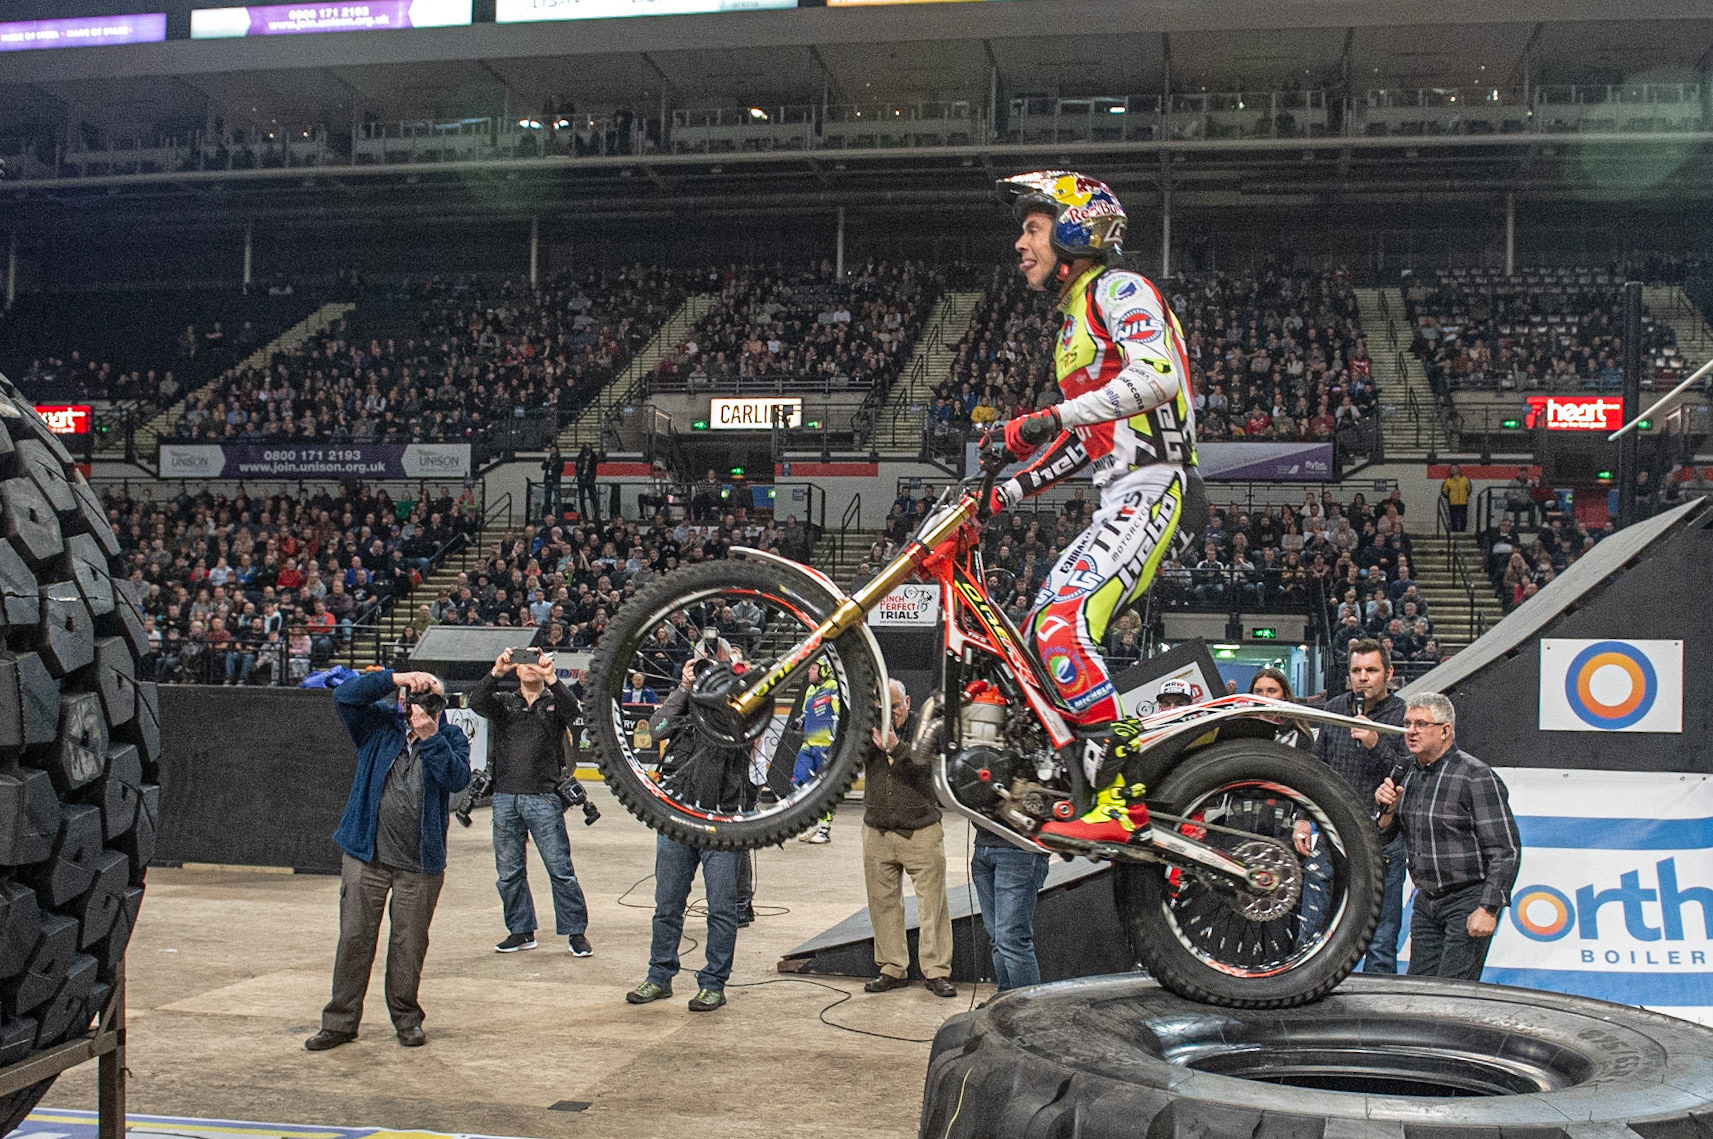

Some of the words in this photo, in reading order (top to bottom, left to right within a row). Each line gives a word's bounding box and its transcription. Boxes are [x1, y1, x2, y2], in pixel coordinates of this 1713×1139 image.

[264, 449, 305, 461] 0800
[308, 449, 326, 461] 171
[328, 449, 362, 461] 2193
[418, 455, 460, 467] UNISON
[239, 460, 387, 474] www.join.unison.org.uk
[886, 595, 905, 603] INCH
[880, 601, 916, 610] PERFECT
[880, 611, 919, 619] TRIALS
